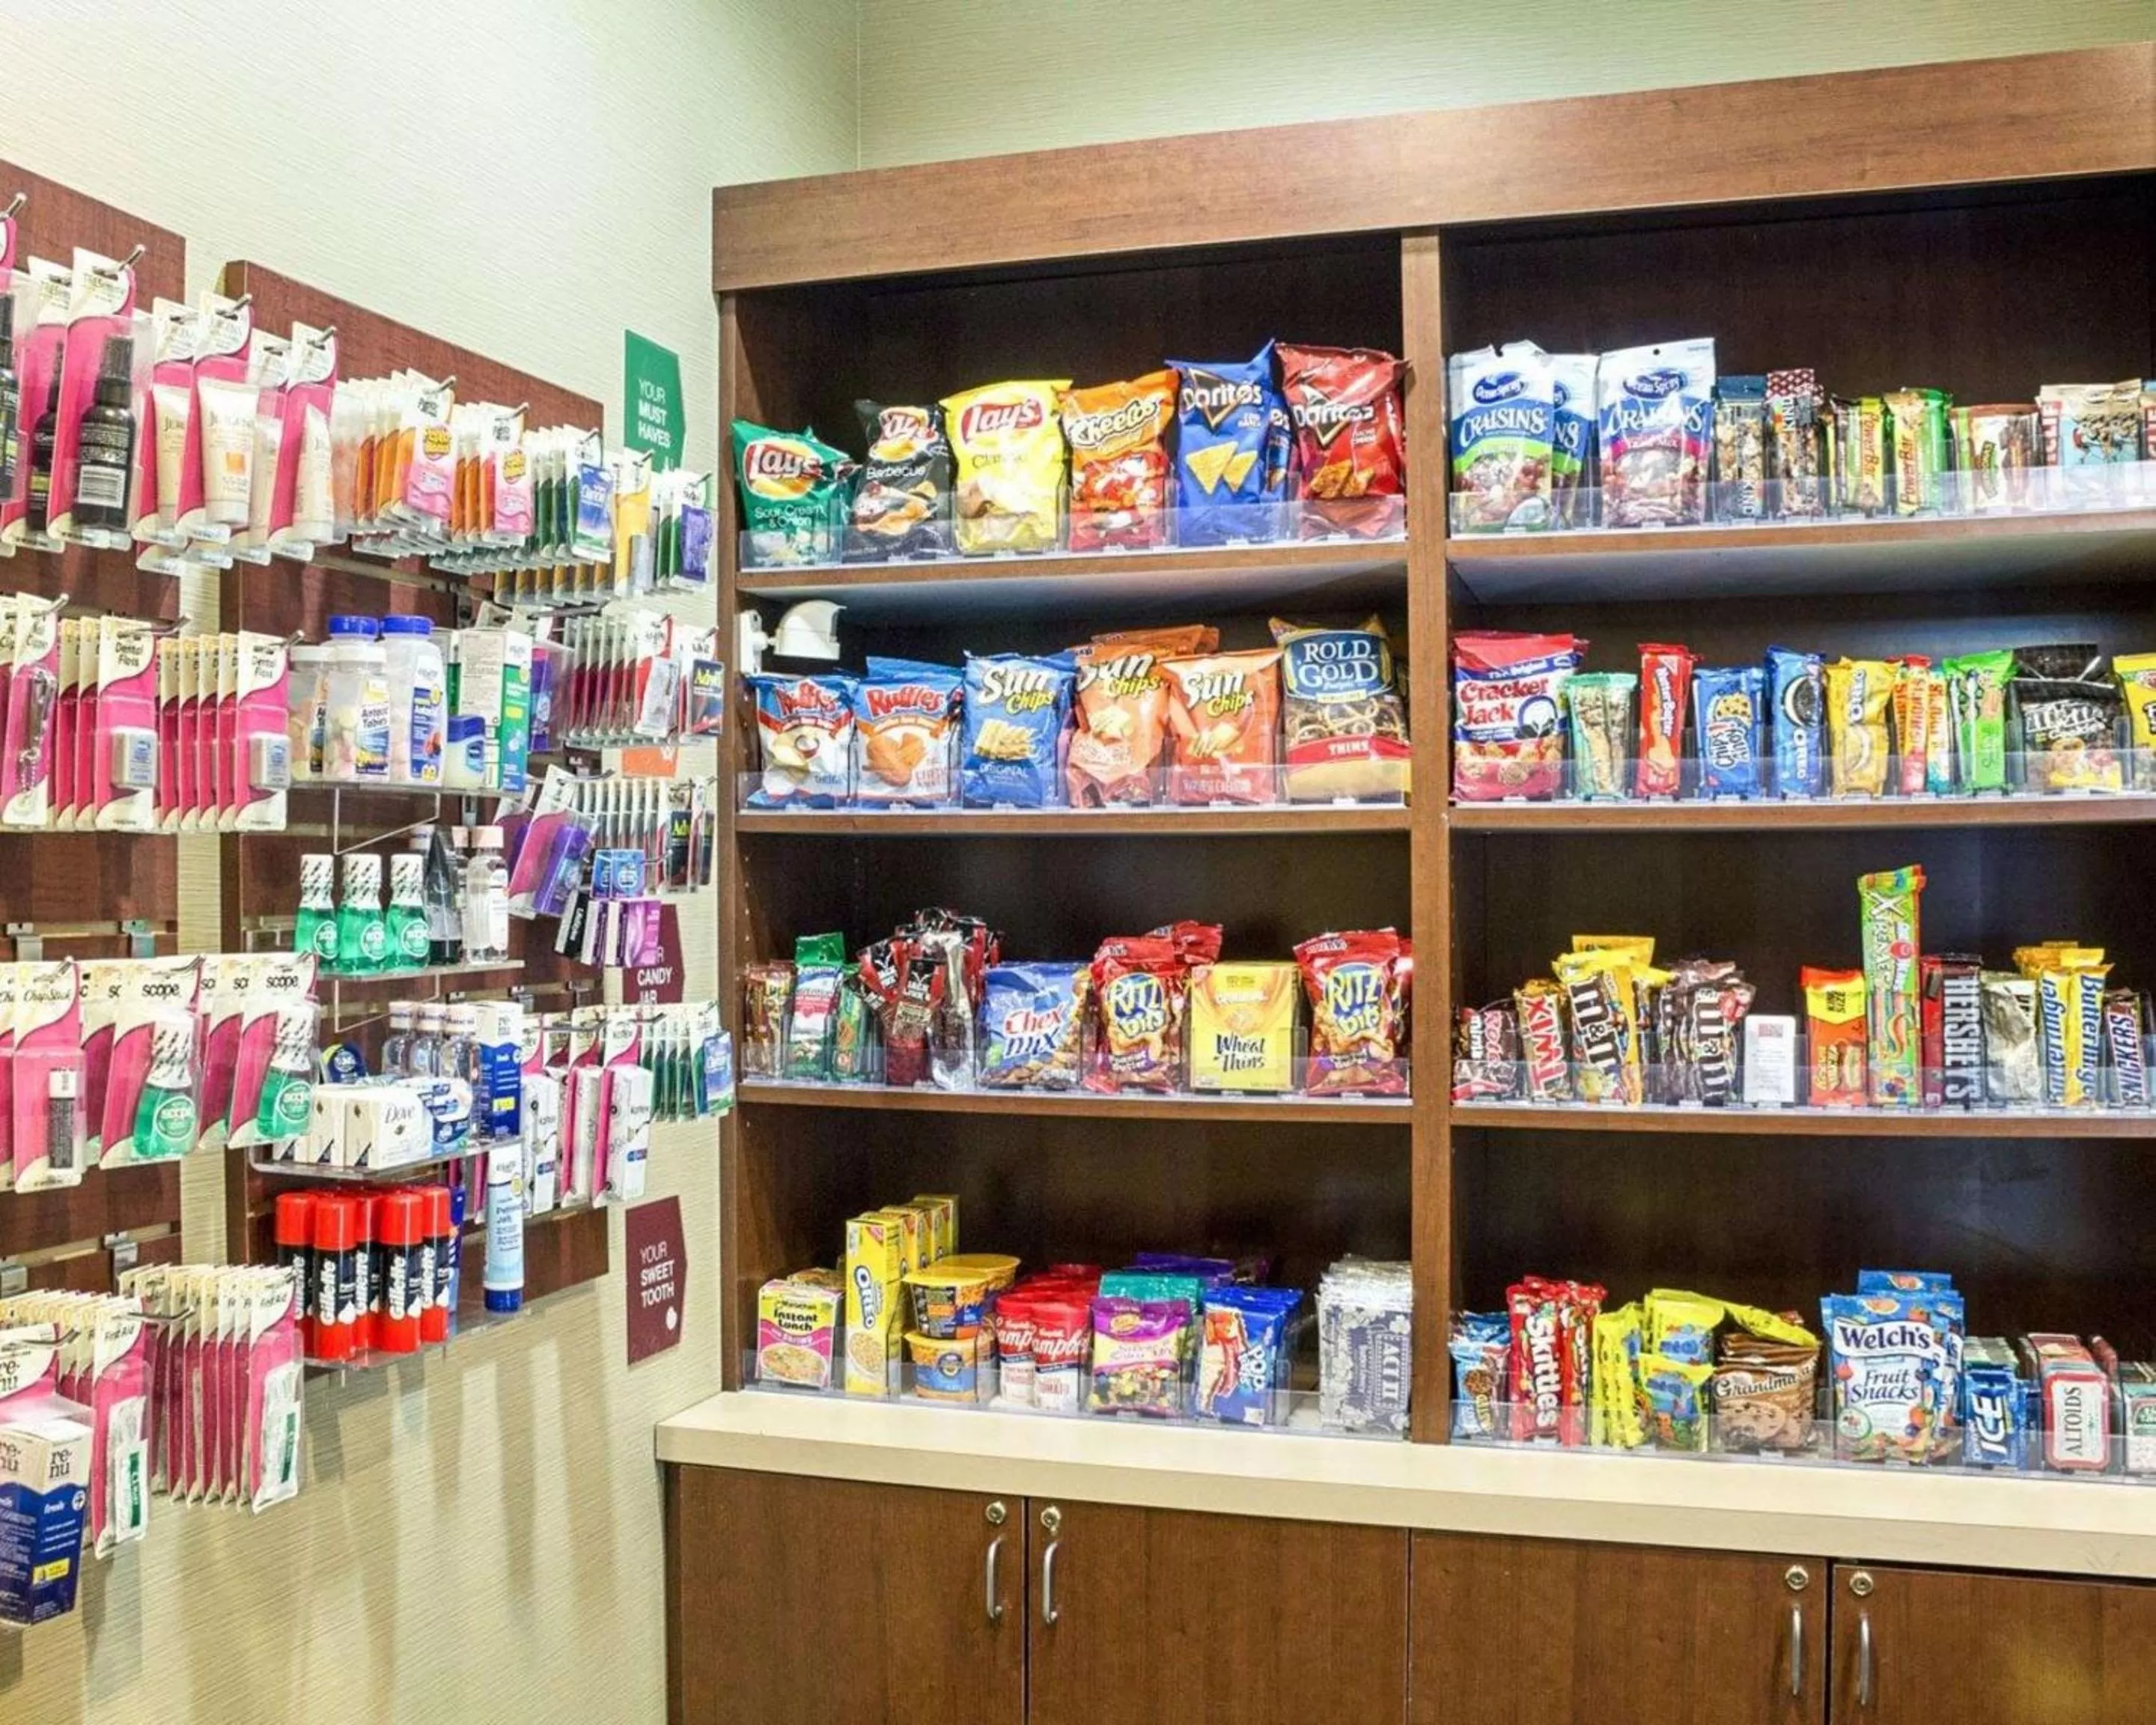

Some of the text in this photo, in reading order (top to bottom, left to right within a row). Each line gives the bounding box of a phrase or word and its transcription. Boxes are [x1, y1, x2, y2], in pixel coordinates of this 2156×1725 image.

[638, 379, 666, 404] YOUR
[1183, 382, 1263, 410] Doritos
[638, 401, 668, 427] MUST
[963, 400, 1042, 444] Lay's
[1069, 397, 1161, 446] Cheetos
[1294, 405, 1375, 428] Doritos
[1460, 407, 1547, 448] CRAISINS
[637, 421, 672, 448] HAVES
[1862, 413, 1878, 478] PowerBar
[748, 445, 821, 480] Lay's
[1900, 429, 1919, 506] PowerBar
[115, 642, 143, 656] Dental
[118, 654, 140, 667] Floss
[1303, 639, 1371, 663] ROLD
[978, 668, 1050, 705] Sun
[1077, 654, 1154, 693] Sun
[1104, 675, 1161, 699] Chips
[1298, 660, 1379, 687] GOLD
[865, 685, 943, 719] Ruffles
[1005, 690, 1055, 716] Chips
[1184, 672, 1245, 709] Sun
[1461, 678, 1549, 702] Cracker
[1207, 689, 1253, 719] Chips
[1464, 703, 1514, 725] Jack
[1709, 732, 1735, 768] Chips
[1794, 728, 1807, 779] OREO
[266, 975, 299, 994] scope
[637, 967, 673, 986] CANDY
[141, 982, 181, 1004] scope
[1106, 979, 1160, 1016] RITZ
[1324, 971, 1383, 1017] RITZ
[1004, 1004, 1064, 1035] Chex
[1216, 1032, 1266, 1055] Wheat
[1523, 997, 1568, 1090] TWIX
[1944, 977, 1981, 1102] HERSHEY'S
[1213, 1053, 1266, 1072] Thins
[2108, 1012, 2145, 1108] SNICKERS
[640, 1241, 667, 1265] YOUR
[641, 1259, 674, 1286] SWEET
[641, 1282, 674, 1308] TOOTH
[774, 1309, 817, 1321] Instant
[779, 1318, 812, 1331] Lunch
[1839, 1326, 1931, 1348] Welch's
[1381, 1341, 1401, 1376] ACT
[1524, 1314, 1562, 1427] Skittles
[1865, 1367, 1910, 1387] Fruit
[1850, 1381, 1919, 1405] Snacks
[1973, 1396, 2008, 1454] ICE
[2064, 1386, 2083, 1457] ALTOIDS
[49, 1462, 70, 1479] nu
[51, 1449, 72, 1465] re-
